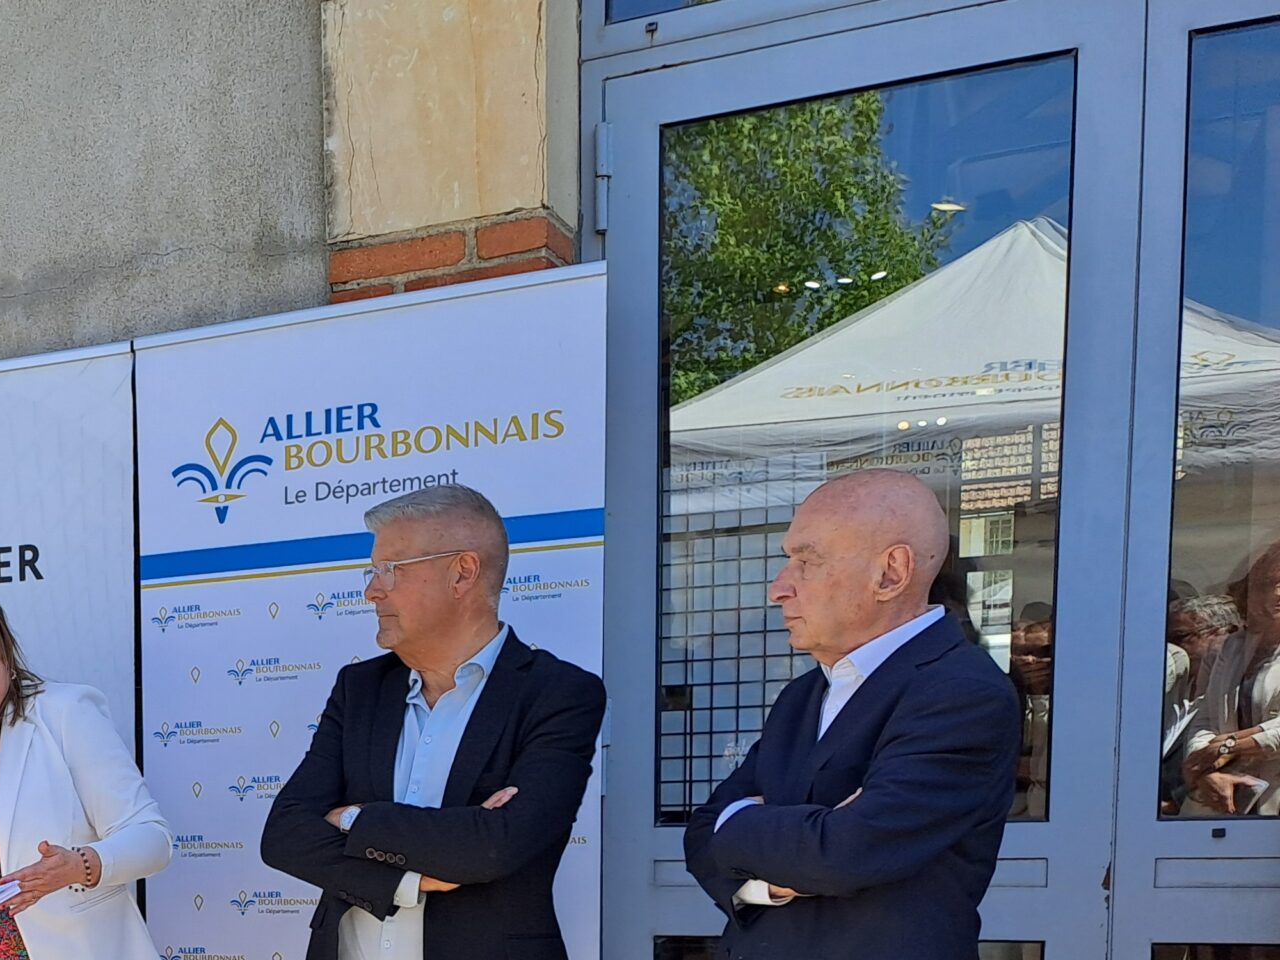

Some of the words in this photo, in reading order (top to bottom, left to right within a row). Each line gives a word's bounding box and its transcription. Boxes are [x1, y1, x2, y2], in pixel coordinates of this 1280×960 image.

[259, 402, 381, 444] ALLIER
[283, 409, 565, 472] BOURBONNAIS
[284, 486, 307, 505] Le
[506, 574, 540, 585] ALLIER
[512, 578, 589, 593] BOURBONNAIS
[330, 590, 362, 600] ALLIER
[172, 604, 201, 614] ALLIER
[178, 608, 241, 621] BOURBONNAIS
[250, 657, 280, 667] ALLIER
[255, 662, 321, 674] BOURBONNAIS
[174, 721, 202, 729] ALLIER
[180, 726, 242, 736] BOURBONNAIS
[251, 775, 280, 784] ALLIER
[175, 834, 203, 843] ALLIER
[181, 841, 243, 850] BOURBONNAIS
[252, 891, 281, 899] ALLIER
[258, 898, 320, 906] BOURBONNAI
